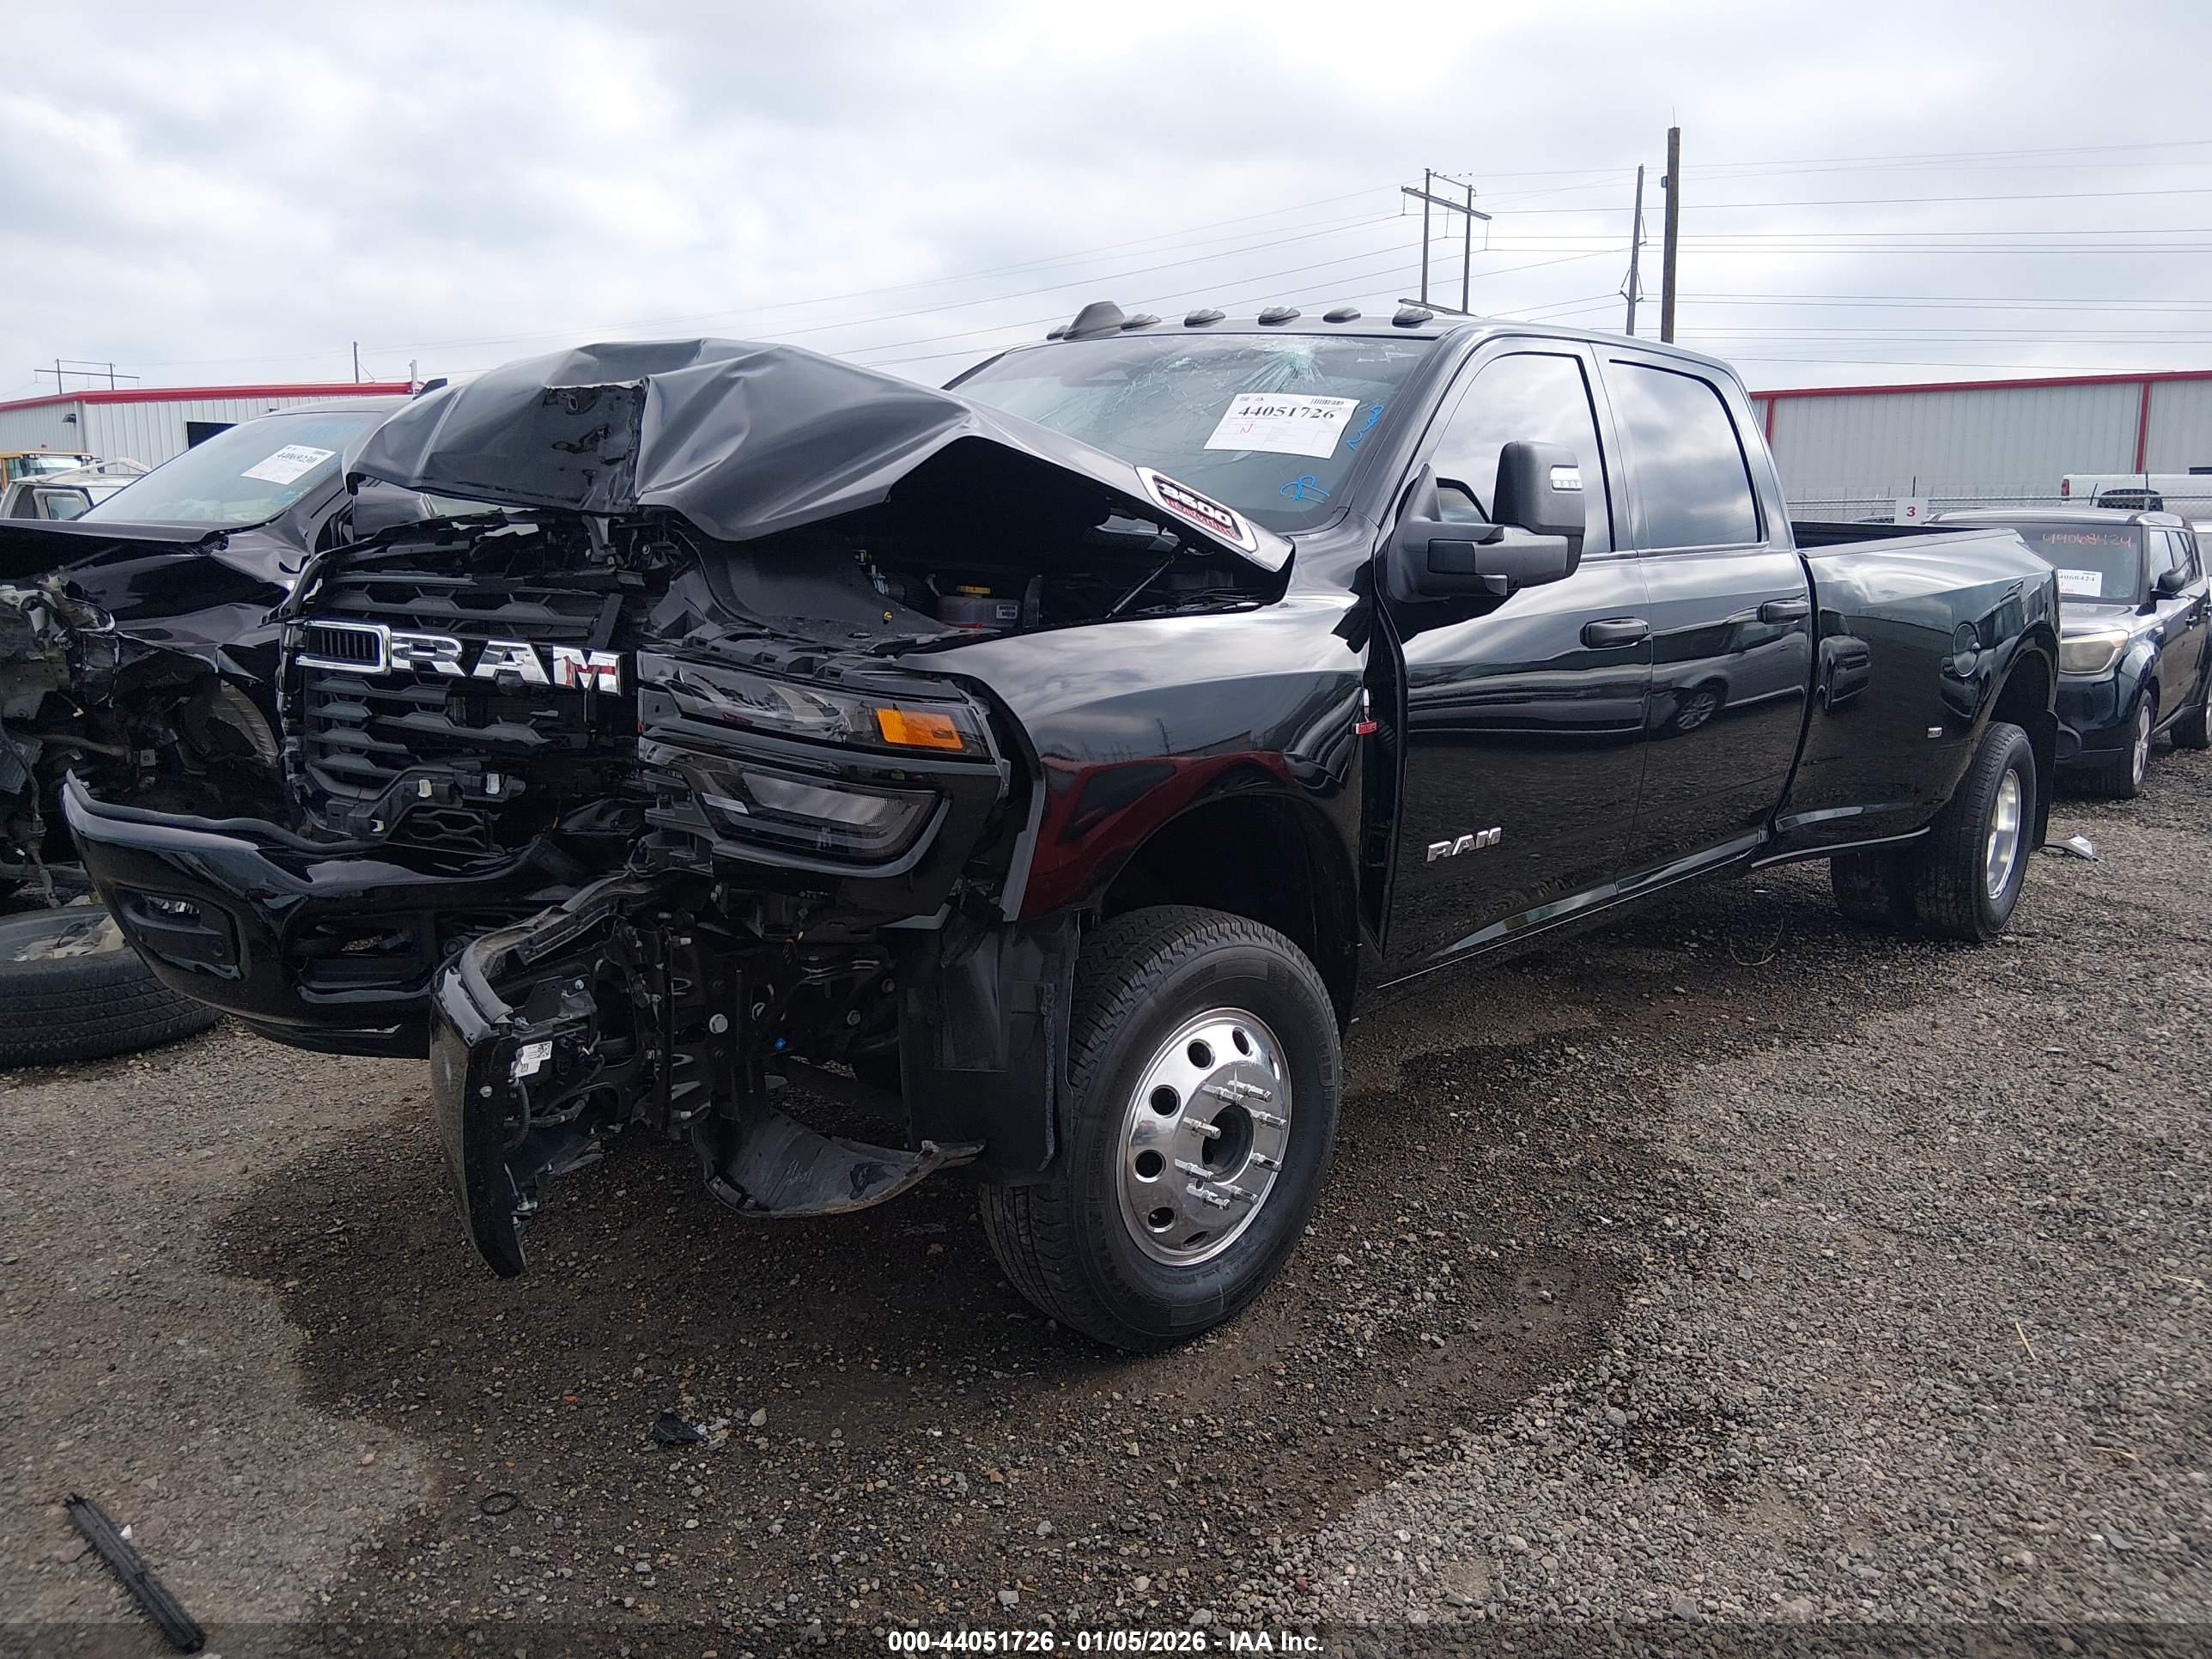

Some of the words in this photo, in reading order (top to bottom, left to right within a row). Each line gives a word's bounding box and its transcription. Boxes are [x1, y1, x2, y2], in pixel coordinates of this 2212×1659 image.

[1238, 406, 1337, 419] 44051726
[1158, 483, 1232, 528] 3500
[1905, 506, 1916, 517] 3
[391, 631, 624, 696] RAM
[1426, 827, 1502, 862] RAM
